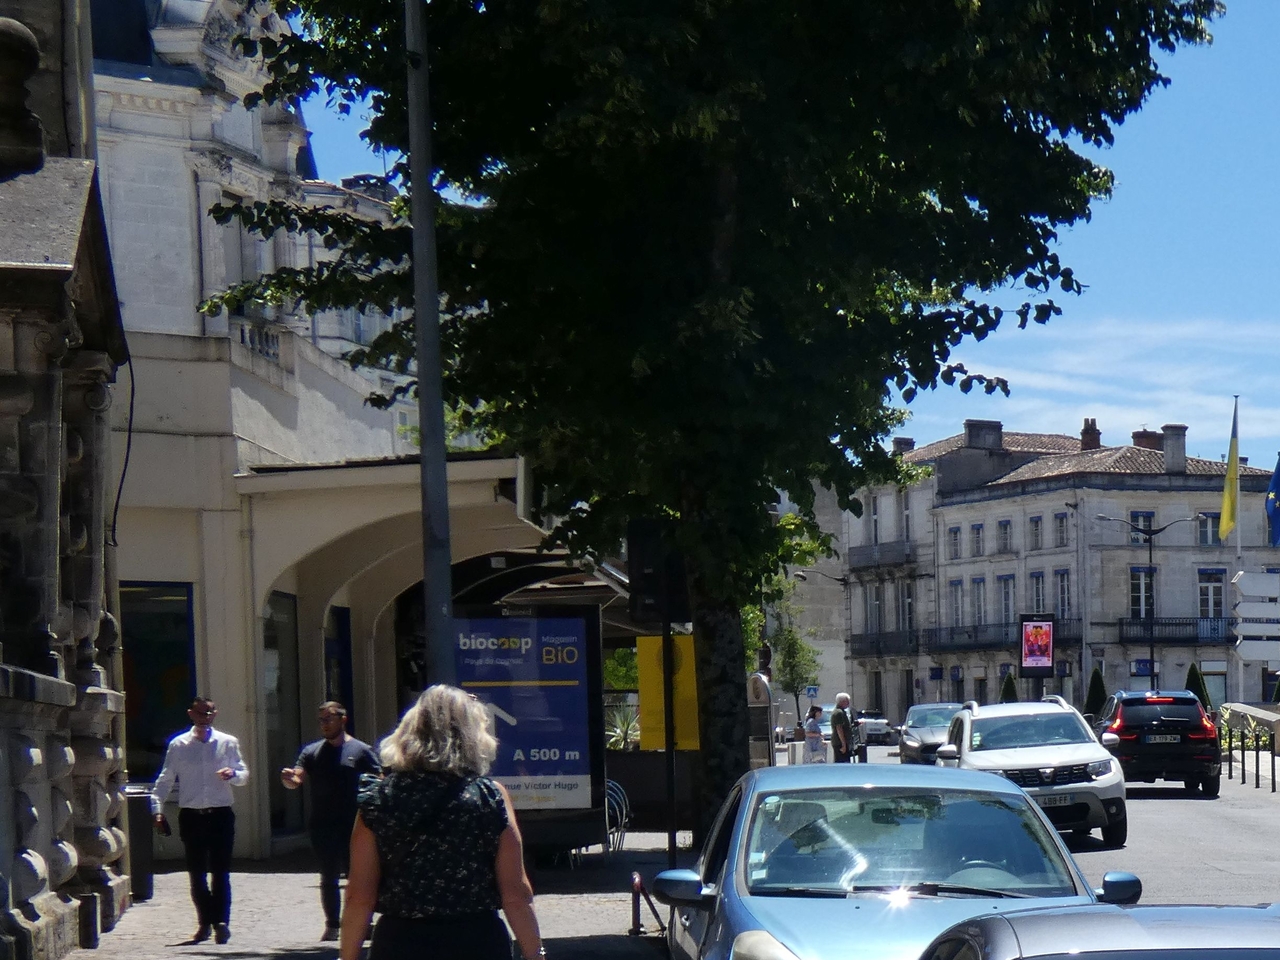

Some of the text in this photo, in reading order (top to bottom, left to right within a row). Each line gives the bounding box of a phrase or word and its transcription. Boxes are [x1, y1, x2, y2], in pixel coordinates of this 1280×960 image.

[459, 633, 532, 654] biocoop
[513, 748, 580, 761] A 500 m
[524, 781, 551, 790] Victor
[554, 781, 579, 791] Hugo
